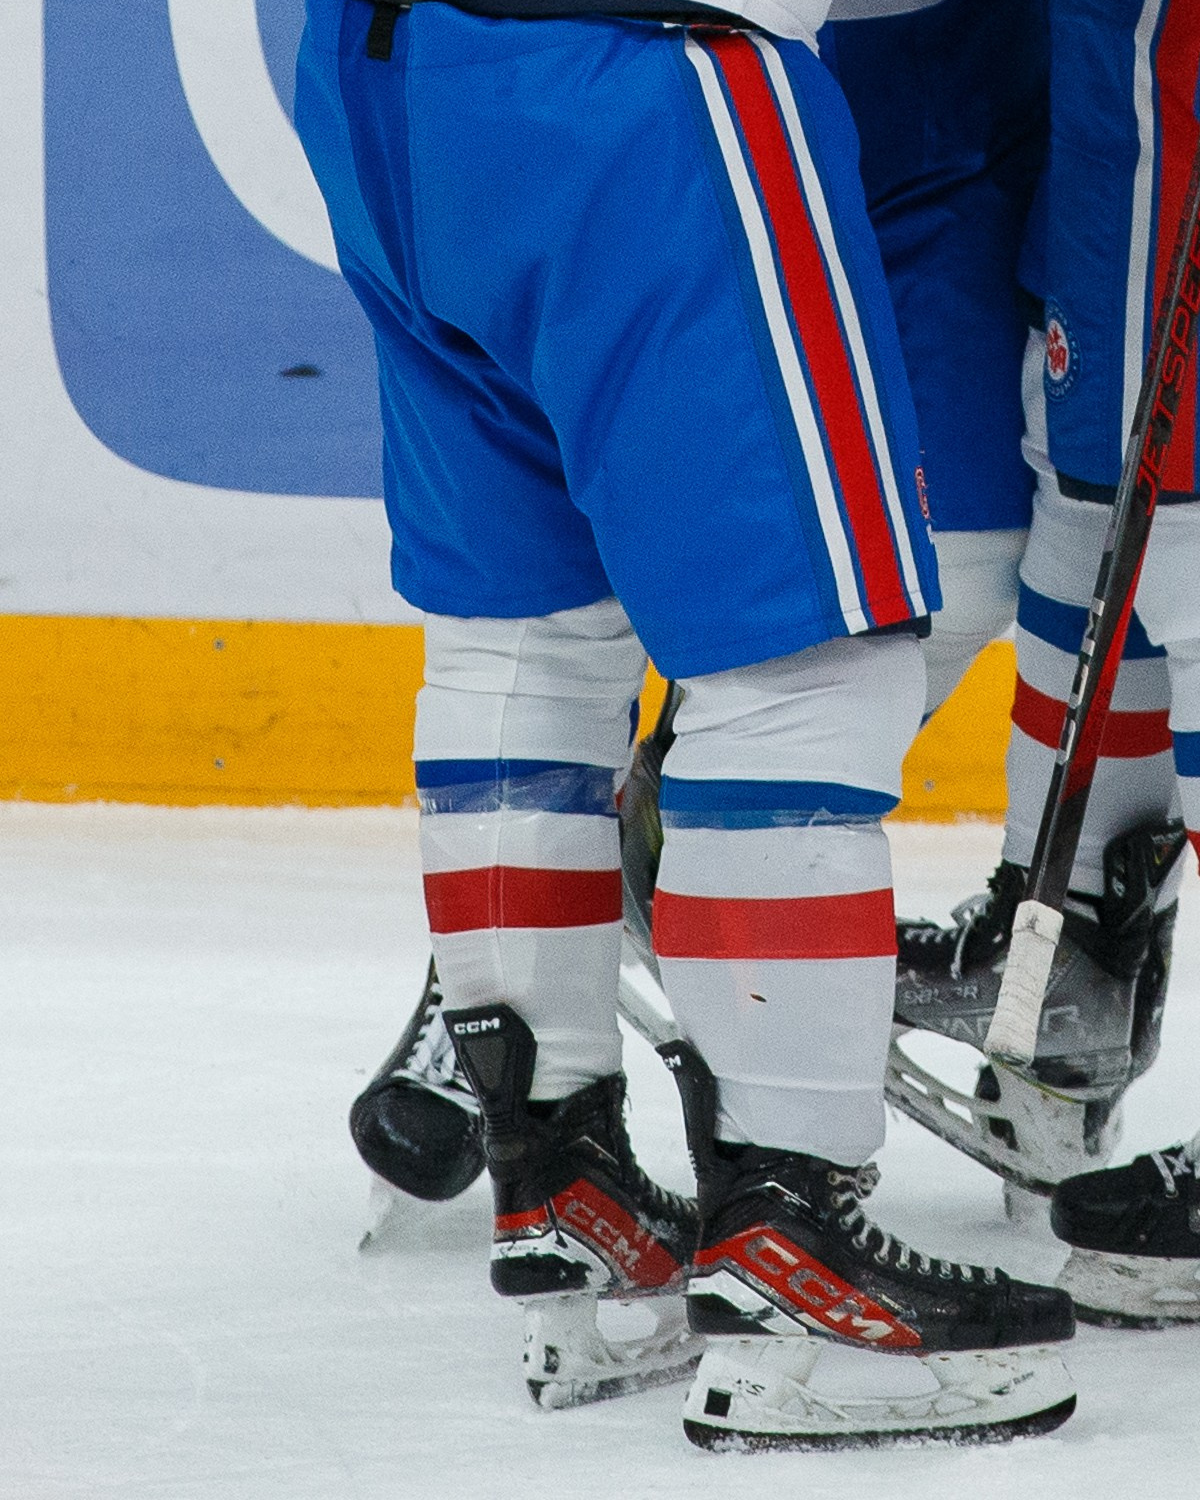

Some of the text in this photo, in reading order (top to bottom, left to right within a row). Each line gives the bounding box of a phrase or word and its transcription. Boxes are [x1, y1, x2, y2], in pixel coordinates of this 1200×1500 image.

[453, 1017, 500, 1035] CCM
[564, 1199, 641, 1269] CCM
[744, 1235, 895, 1341] CCM
